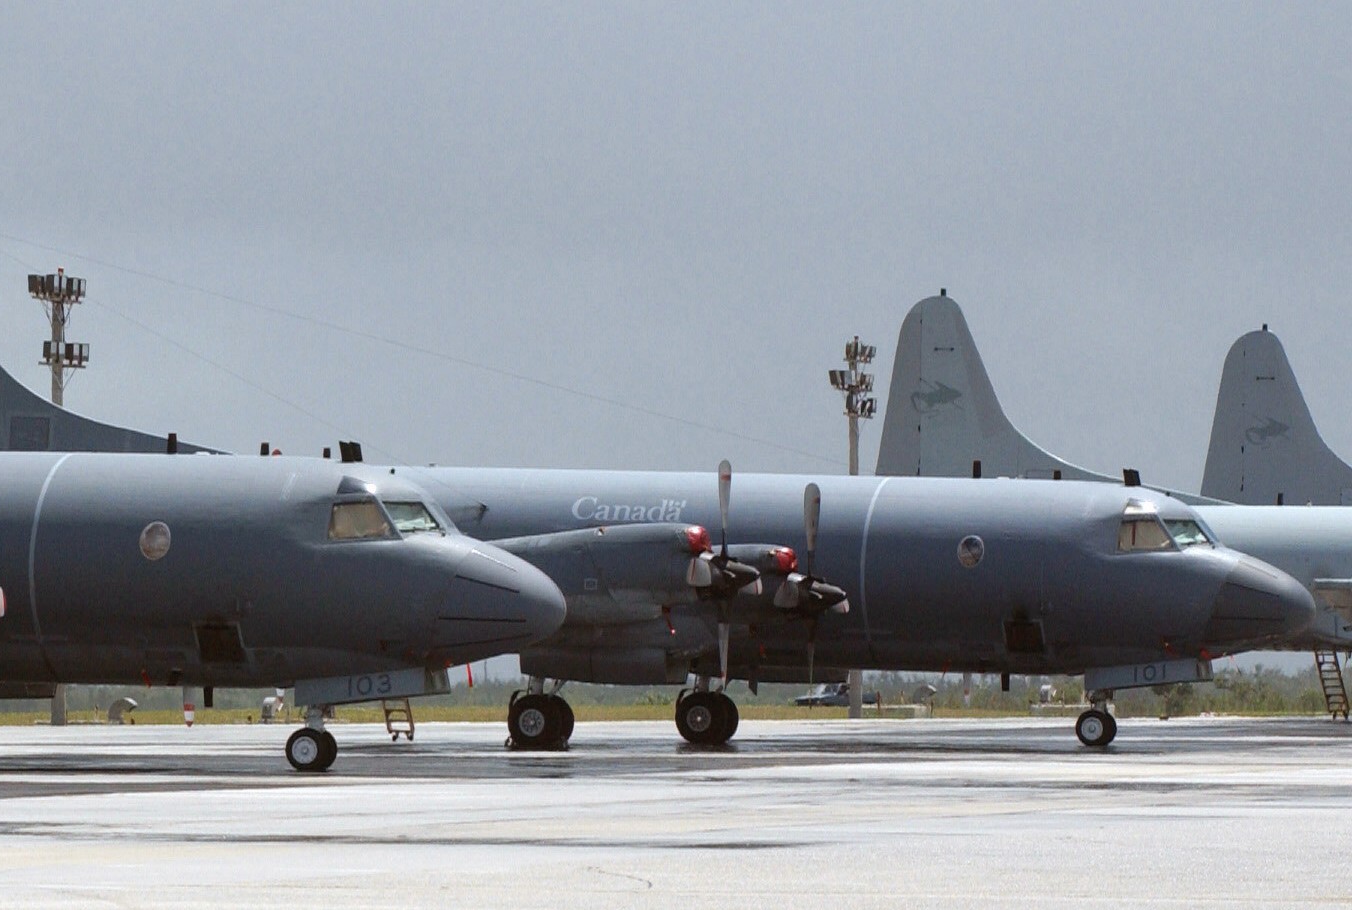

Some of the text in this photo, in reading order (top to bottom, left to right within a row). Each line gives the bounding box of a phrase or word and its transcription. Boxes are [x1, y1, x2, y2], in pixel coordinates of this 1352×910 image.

[571, 496, 685, 521] Canada
[1134, 664, 1166, 682] 101
[348, 674, 392, 697] 103
